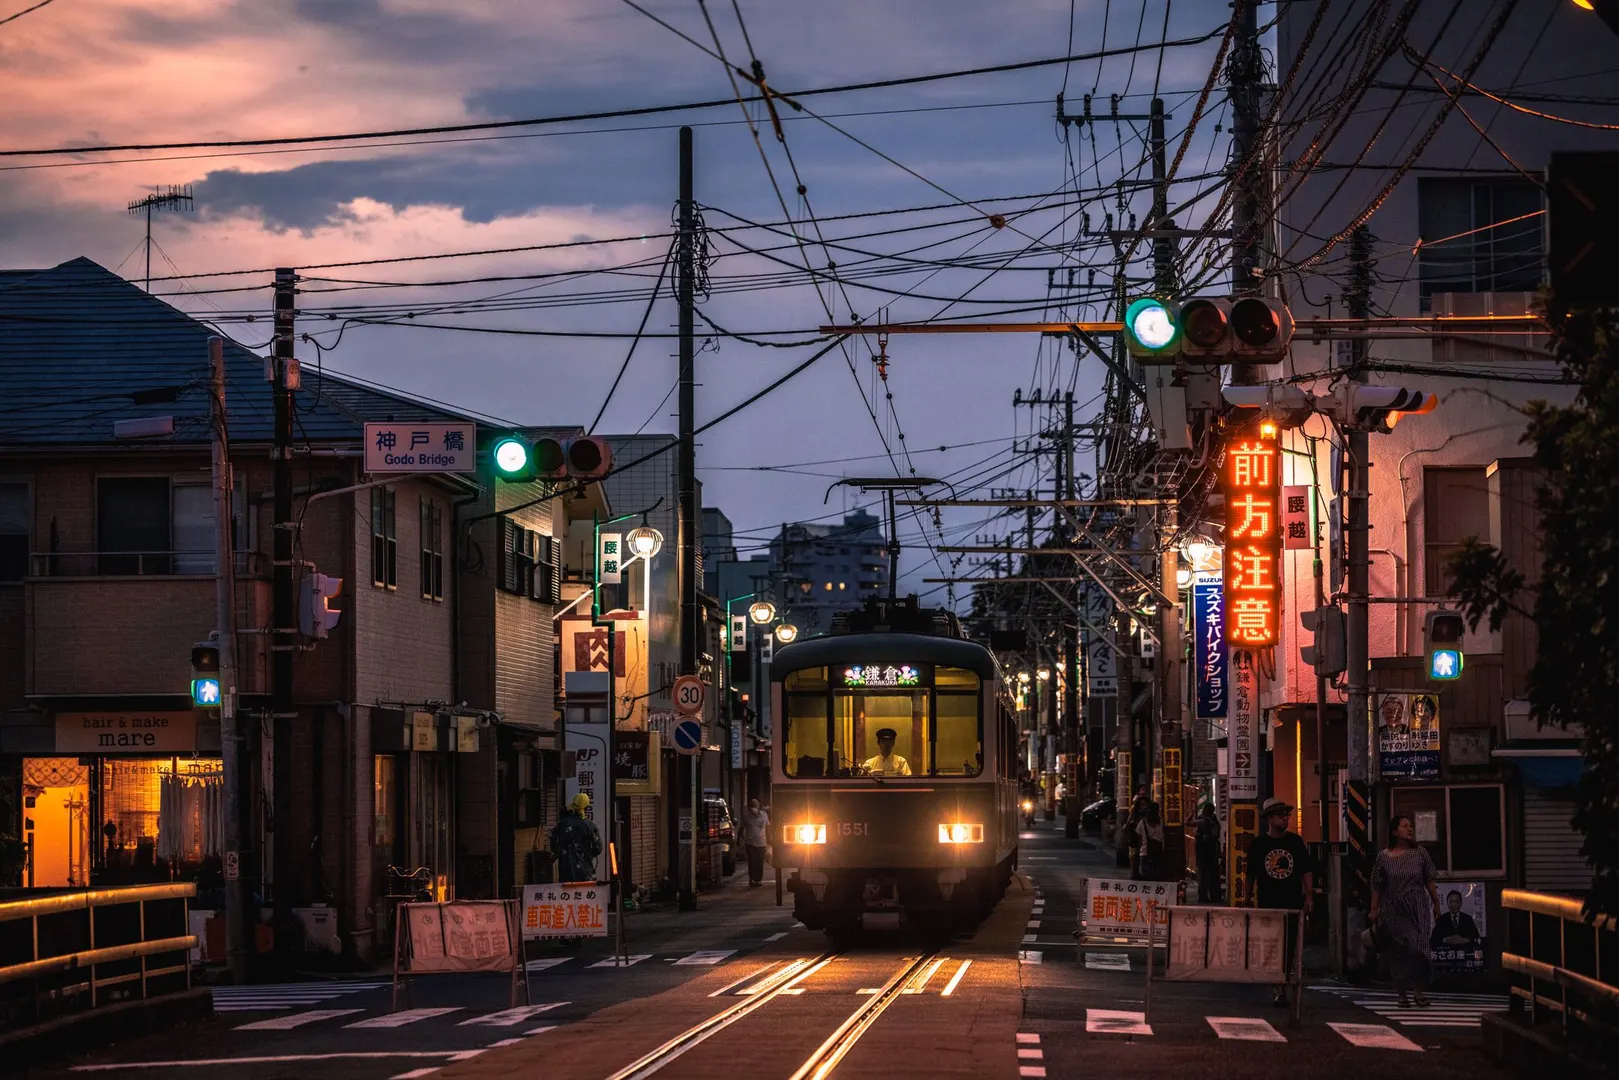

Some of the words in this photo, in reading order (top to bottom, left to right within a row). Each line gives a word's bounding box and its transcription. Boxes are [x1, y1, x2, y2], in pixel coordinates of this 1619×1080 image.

[375, 430, 464, 451] 神戸橋
[384, 454, 415, 465] Godo
[418, 453, 456, 468] Bridge
[1287, 495, 1307, 540] 腰越
[1230, 442, 1273, 642] 前方注意
[604, 541, 617, 574] 腰越
[734, 621, 744, 646] 腰越
[1204, 587, 1222, 712] スズキバイクショップ
[864, 666, 897, 681] 鎌倉
[680, 686, 699, 704] 30
[83, 717, 114, 728] hair
[119, 717, 127, 728] &
[132, 717, 169, 728] make
[98, 732, 156, 747] mare
[837, 823, 868, 836] 1551
[534, 892, 596, 901] 祭礼のため
[1100, 882, 1166, 894] 祭礼のため
[526, 904, 603, 930] 車両進入禁止
